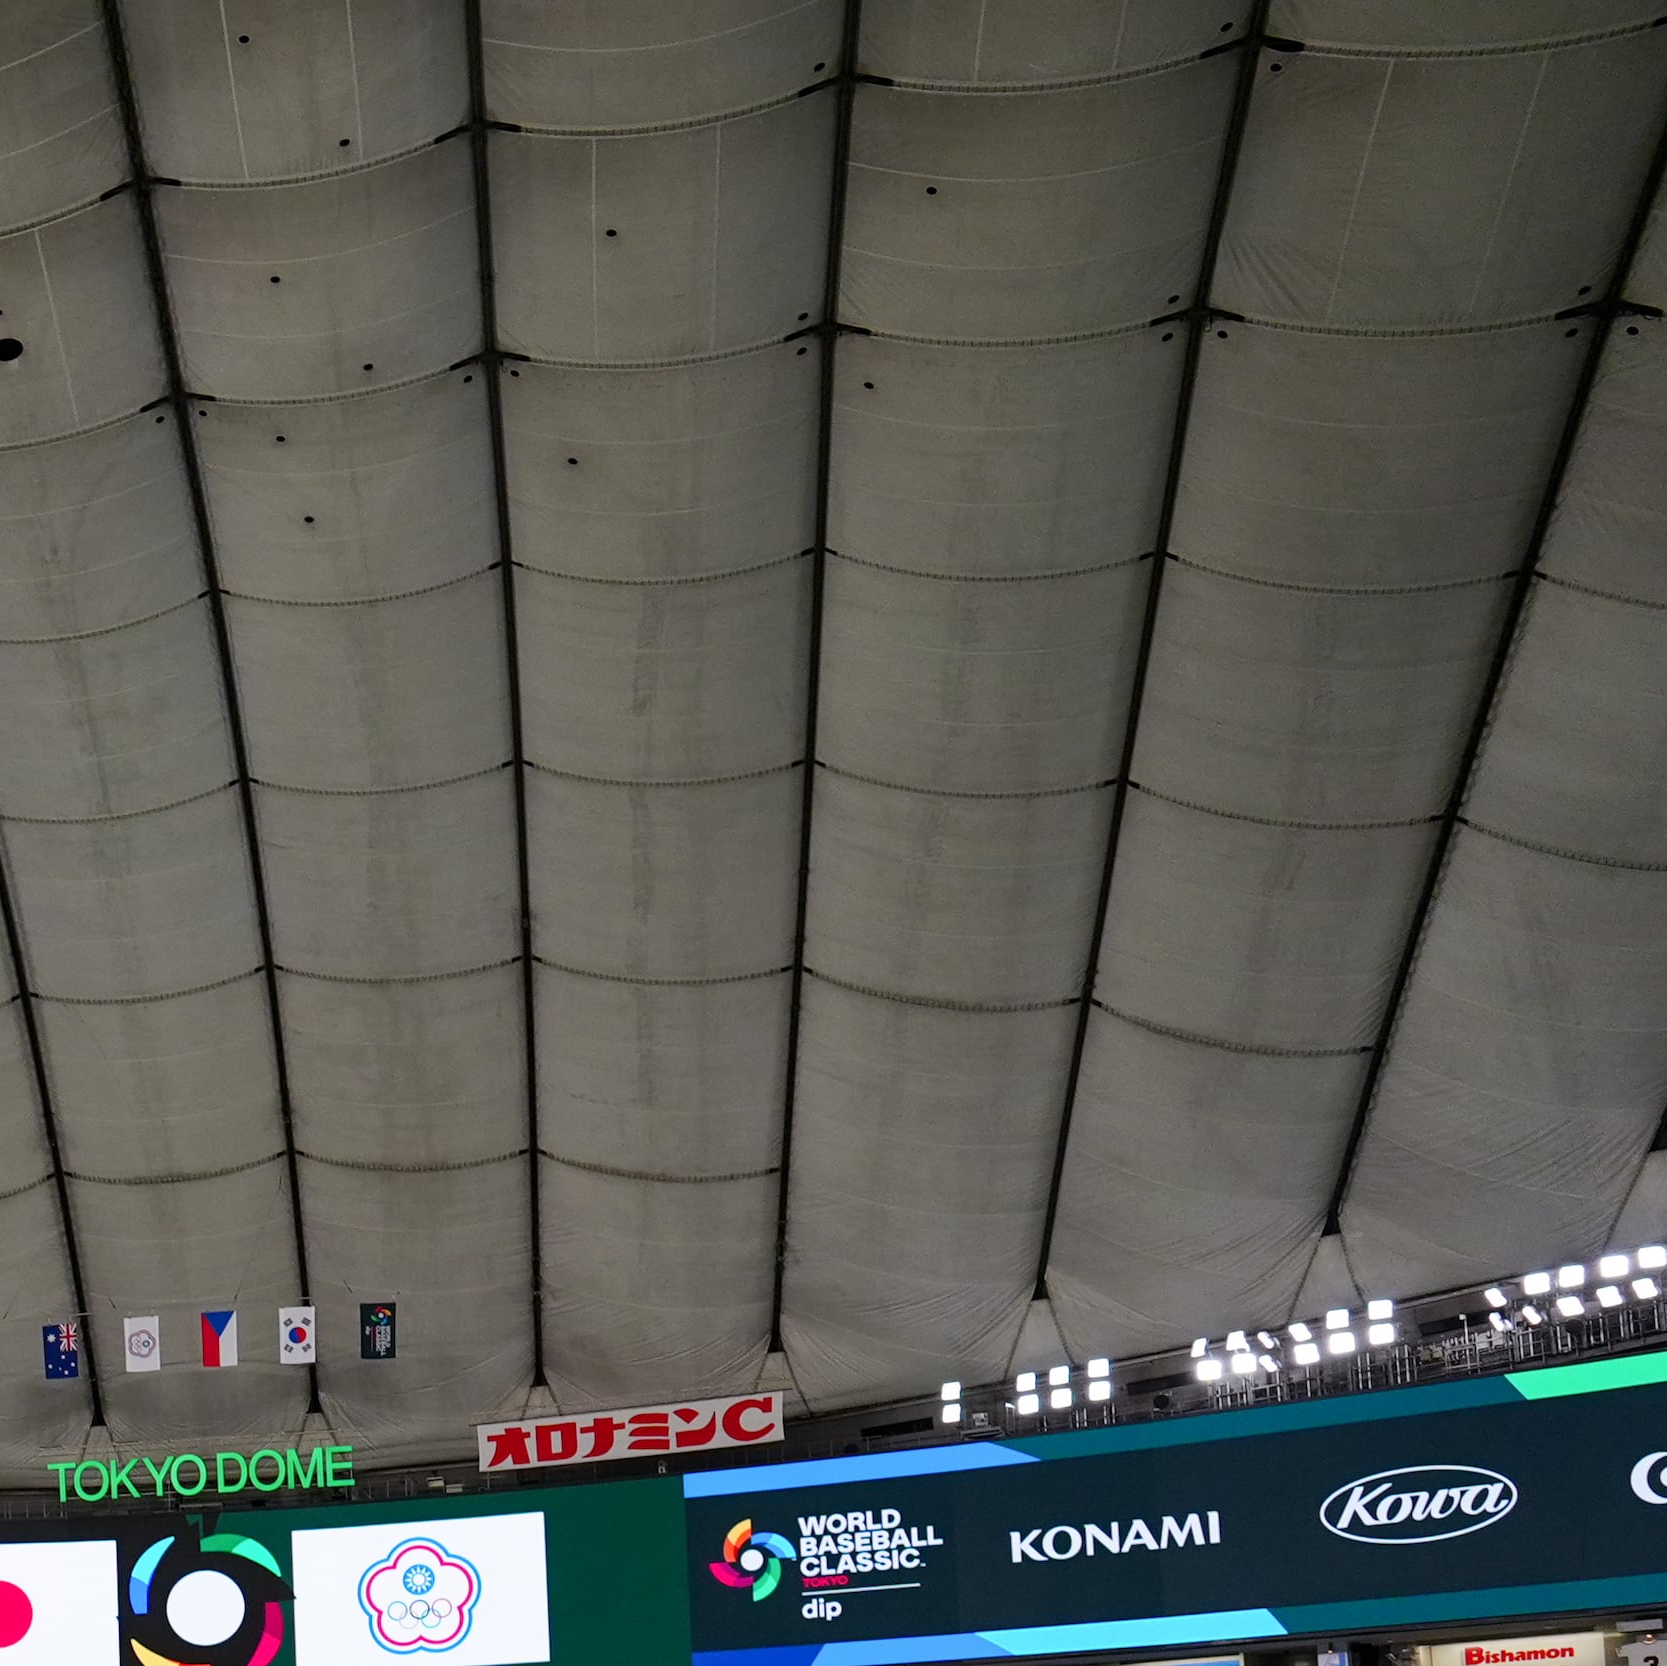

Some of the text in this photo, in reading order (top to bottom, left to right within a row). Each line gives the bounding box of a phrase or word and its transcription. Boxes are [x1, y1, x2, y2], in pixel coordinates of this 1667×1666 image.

[487, 1396, 776, 1469] オロナミンC
[47, 1445, 356, 1502] TOKYO DOME
[1336, 1480, 1510, 1530] Kowa
[798, 1507, 902, 1536] WORLD
[1009, 1510, 1222, 1564] KONAMI
[800, 1524, 944, 1557] BASEBALL
[800, 1548, 921, 1576] CLASSIC
[802, 1575, 849, 1588] TOKYO
[801, 1597, 843, 1621] dip
[1465, 1644, 1575, 1666] Bishamon
